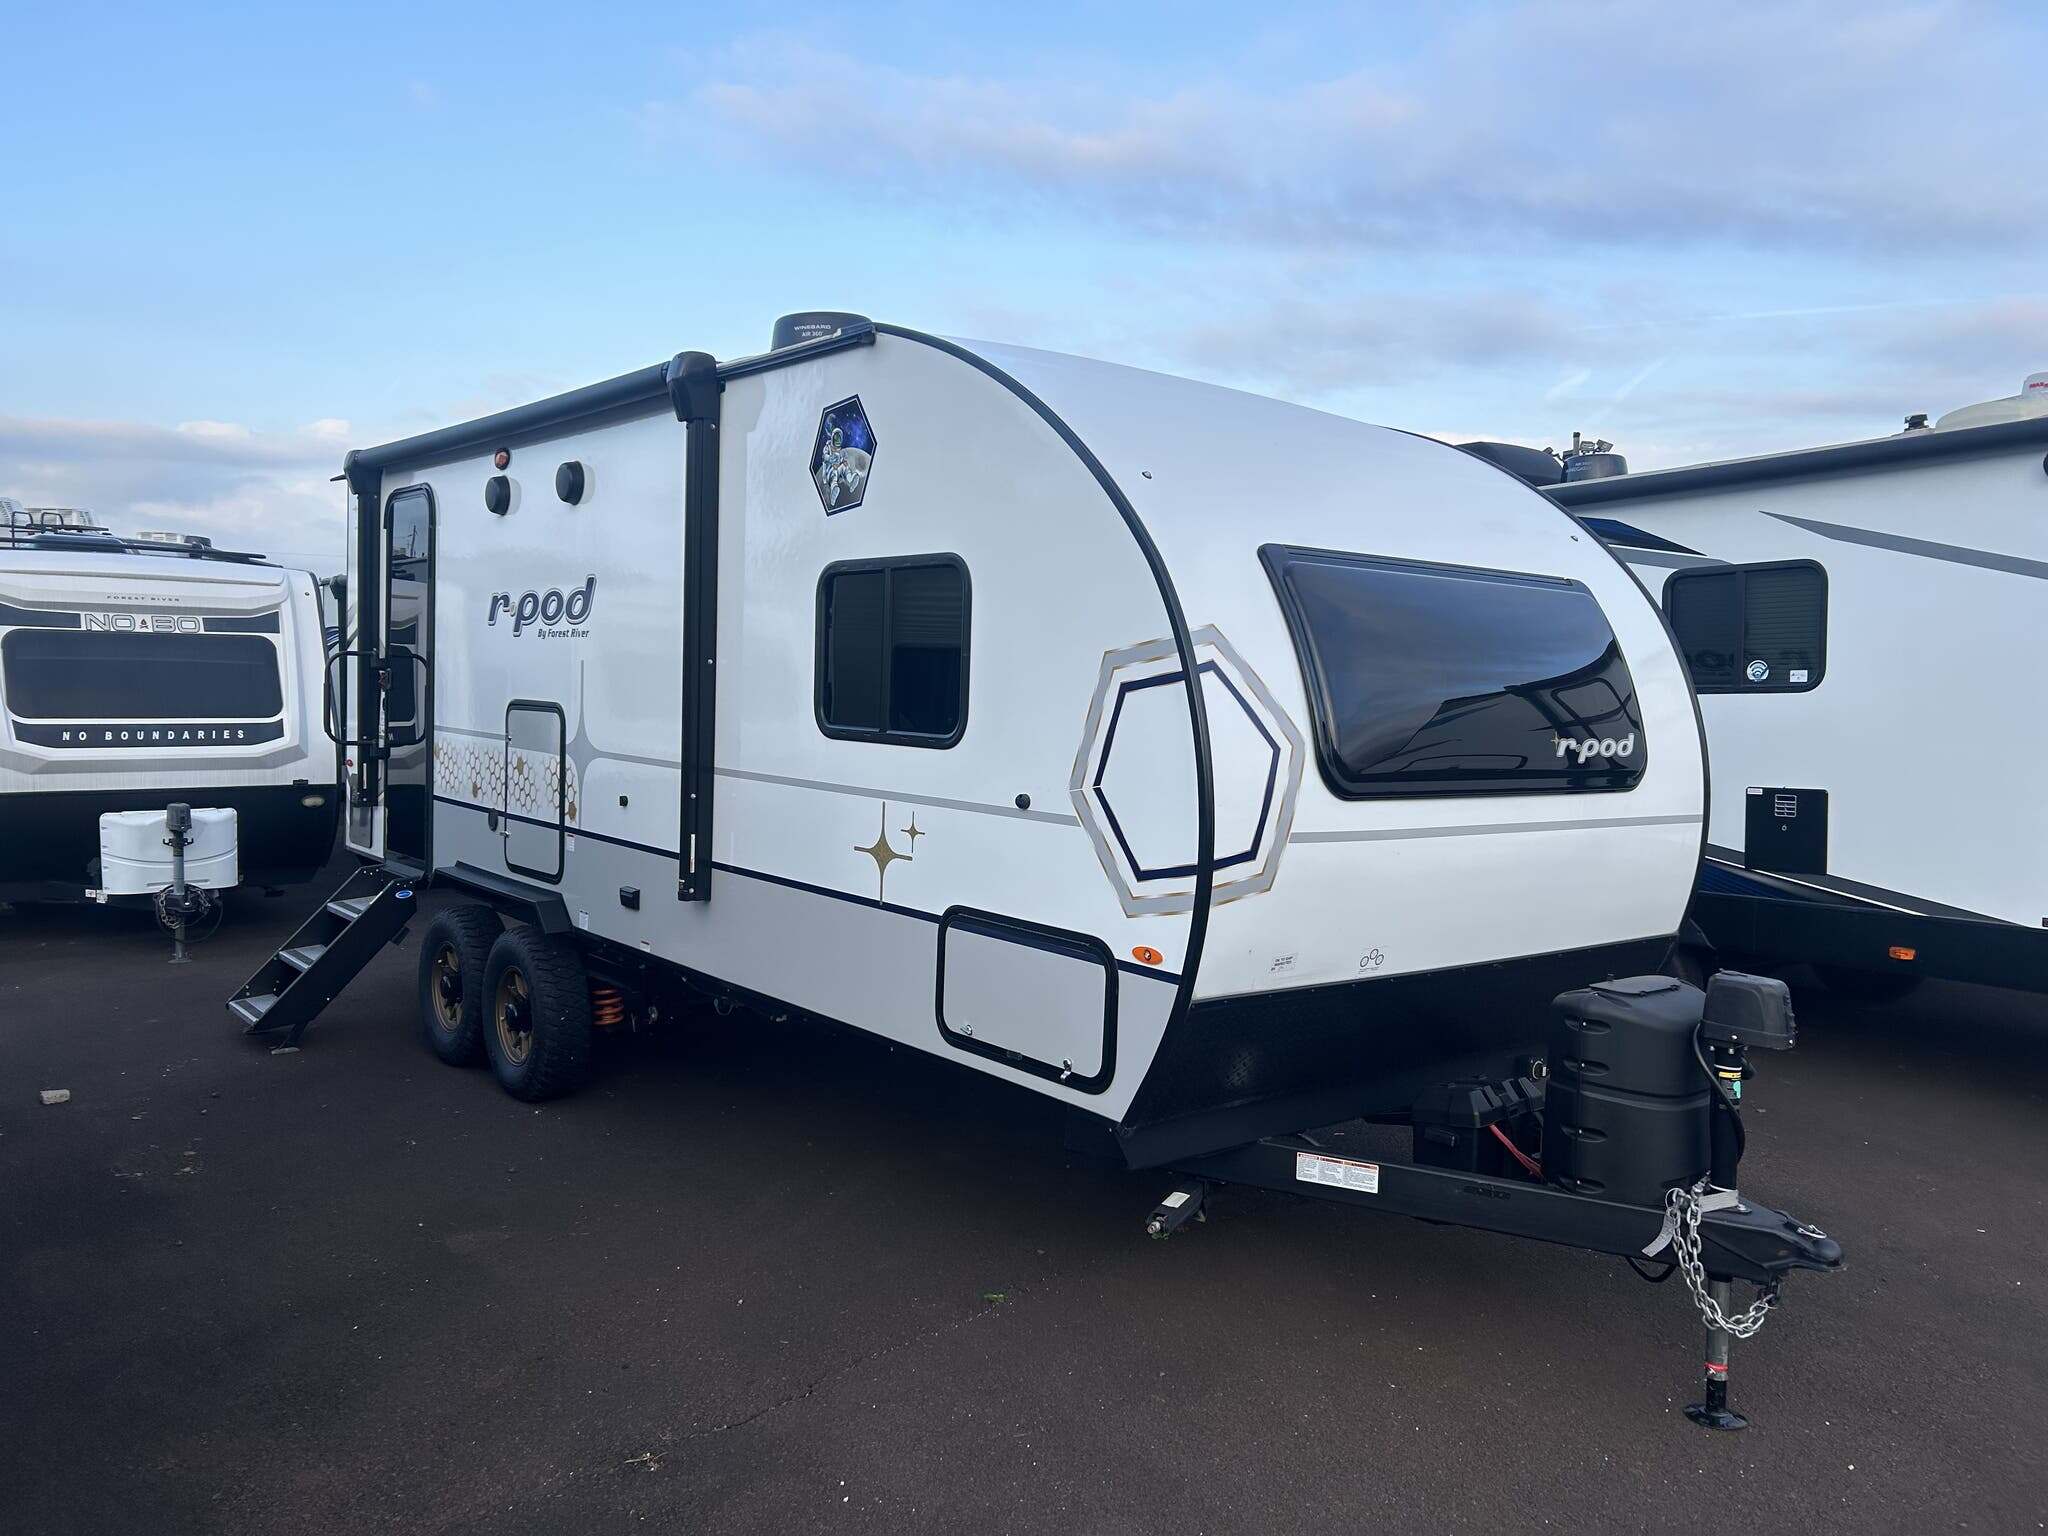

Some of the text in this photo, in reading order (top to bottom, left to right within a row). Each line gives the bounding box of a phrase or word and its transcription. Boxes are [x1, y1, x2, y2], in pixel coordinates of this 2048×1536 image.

[537, 628, 590, 640] By Forest River
[62, 729, 245, 741] NO BOUNDARIES
